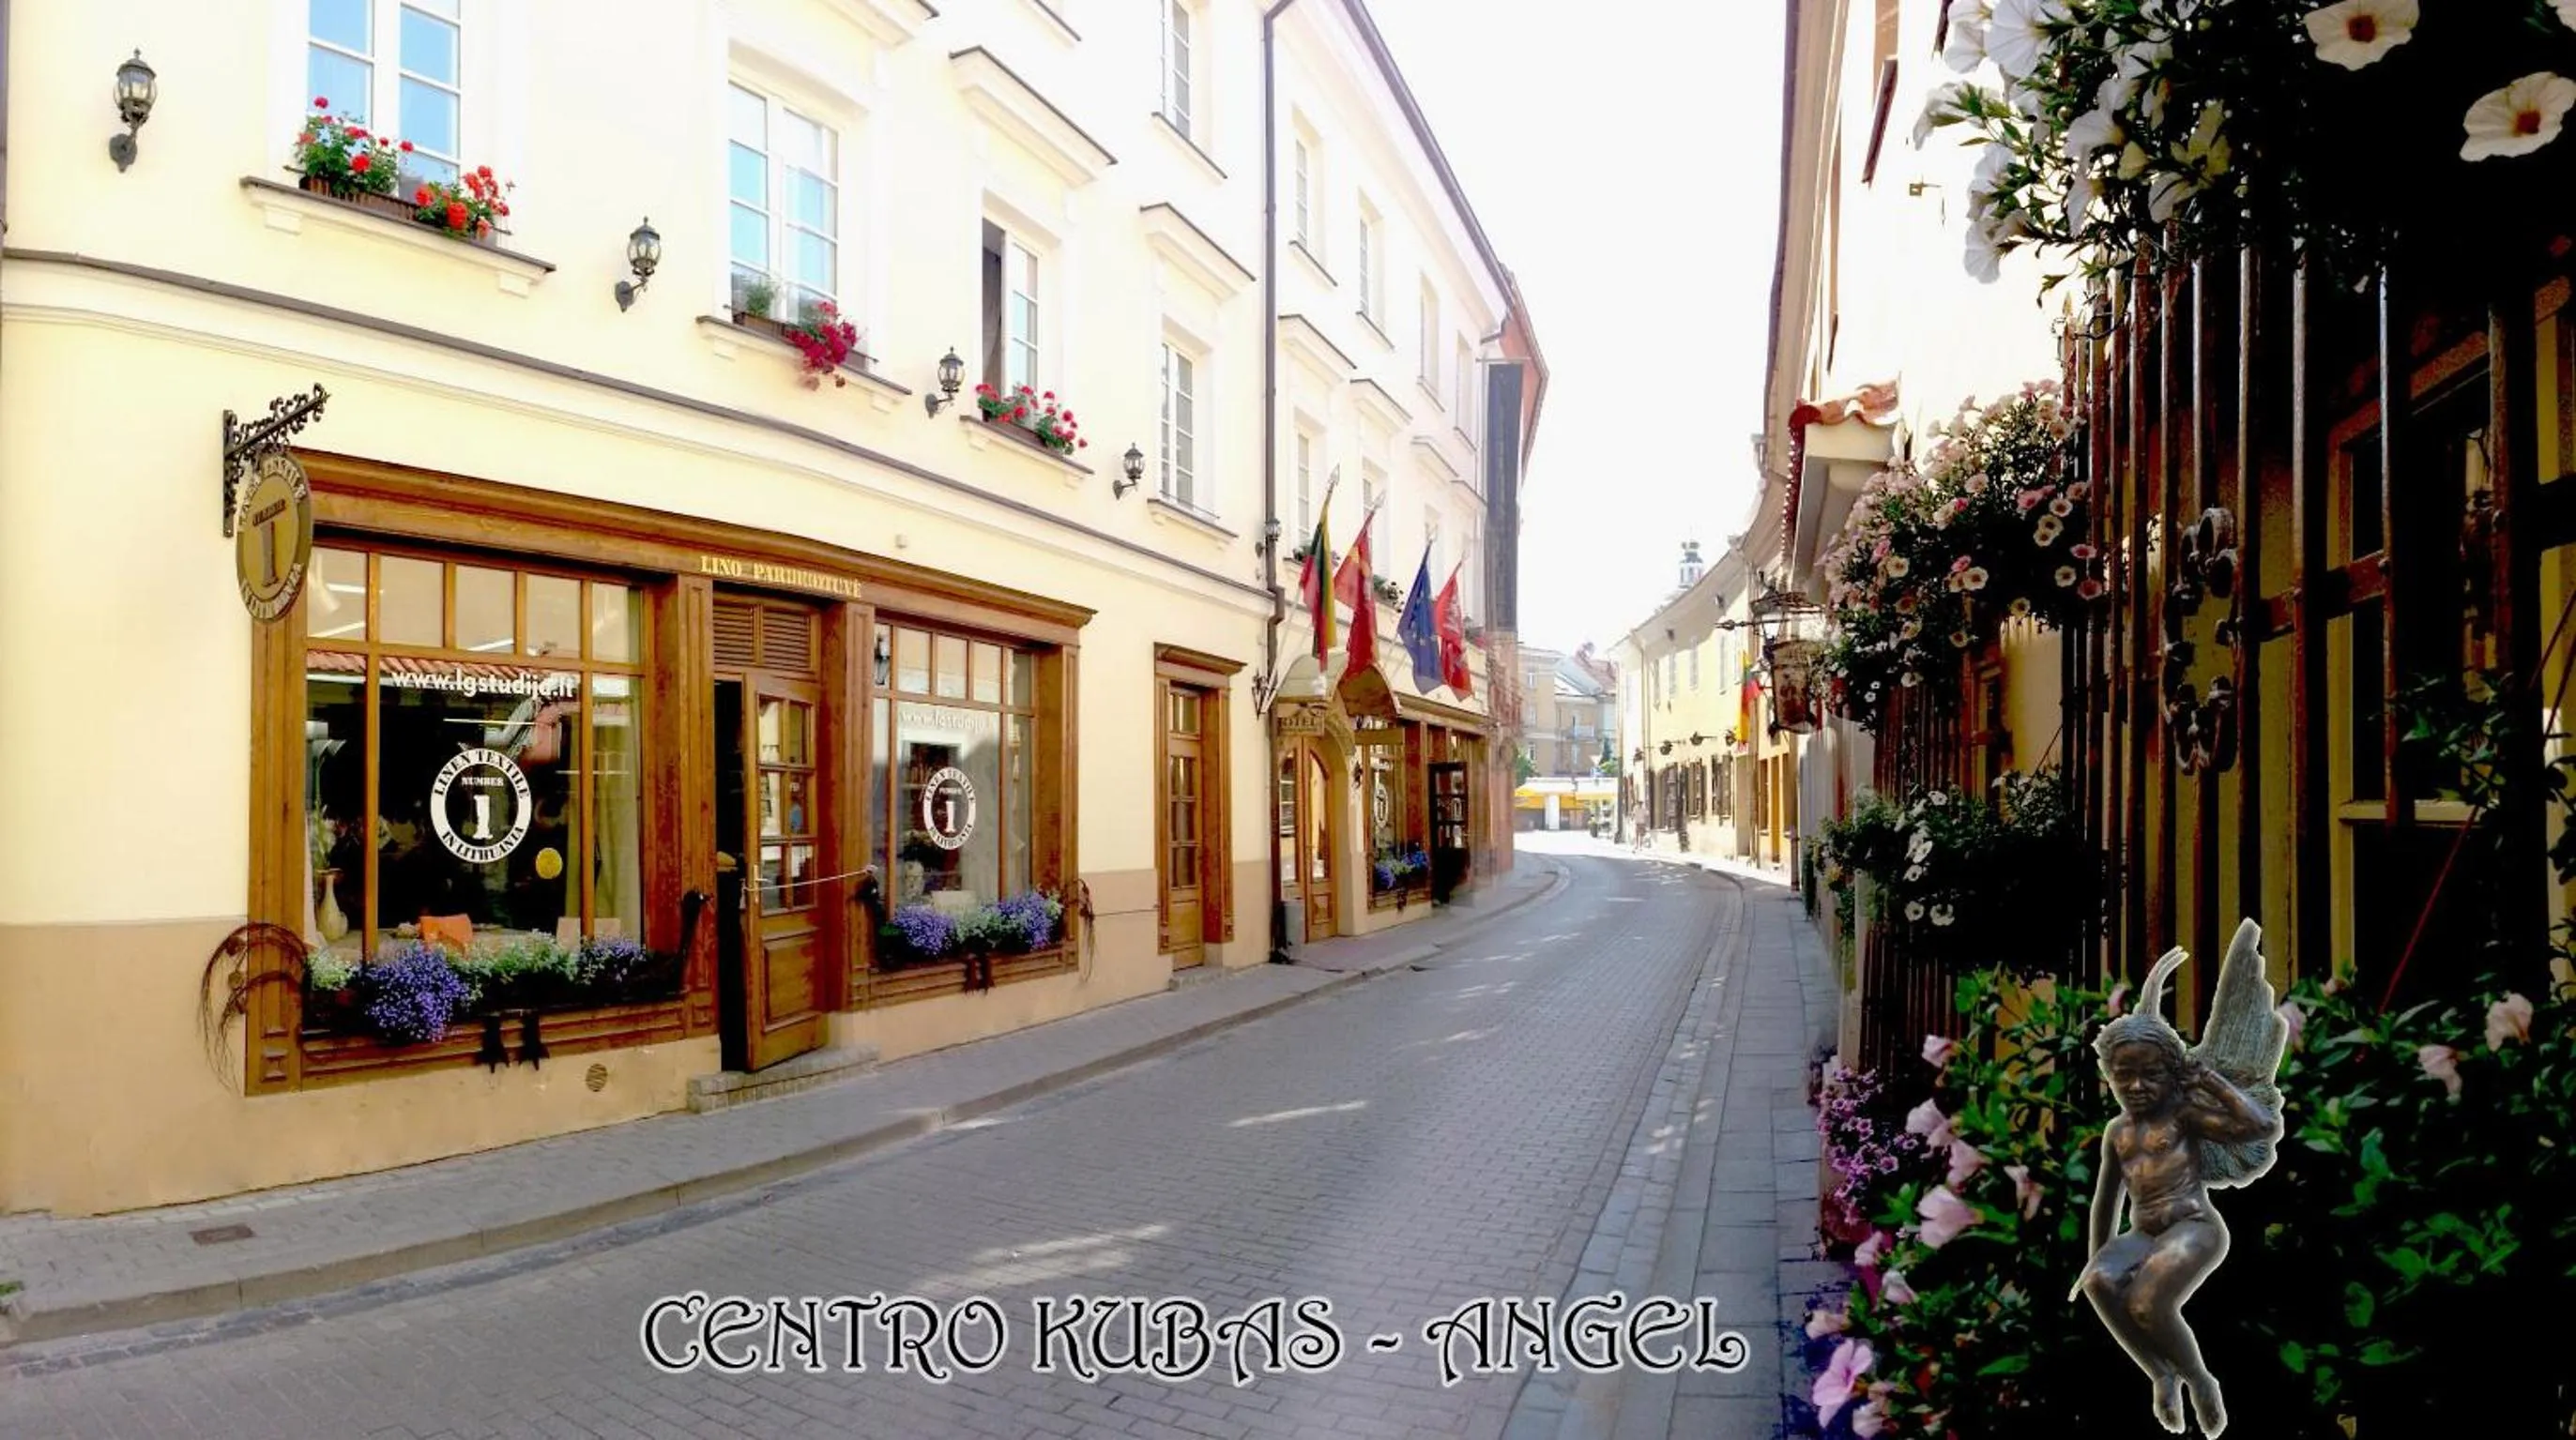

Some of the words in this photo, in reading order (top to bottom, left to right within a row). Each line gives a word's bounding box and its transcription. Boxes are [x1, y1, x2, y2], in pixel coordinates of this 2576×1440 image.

[700, 555, 742, 577] LINO
[434, 752, 471, 796] LINEN
[475, 750, 530, 799] TEXTILE
[472, 794, 494, 841] 1
[455, 826, 525, 861] LITHUANIA
